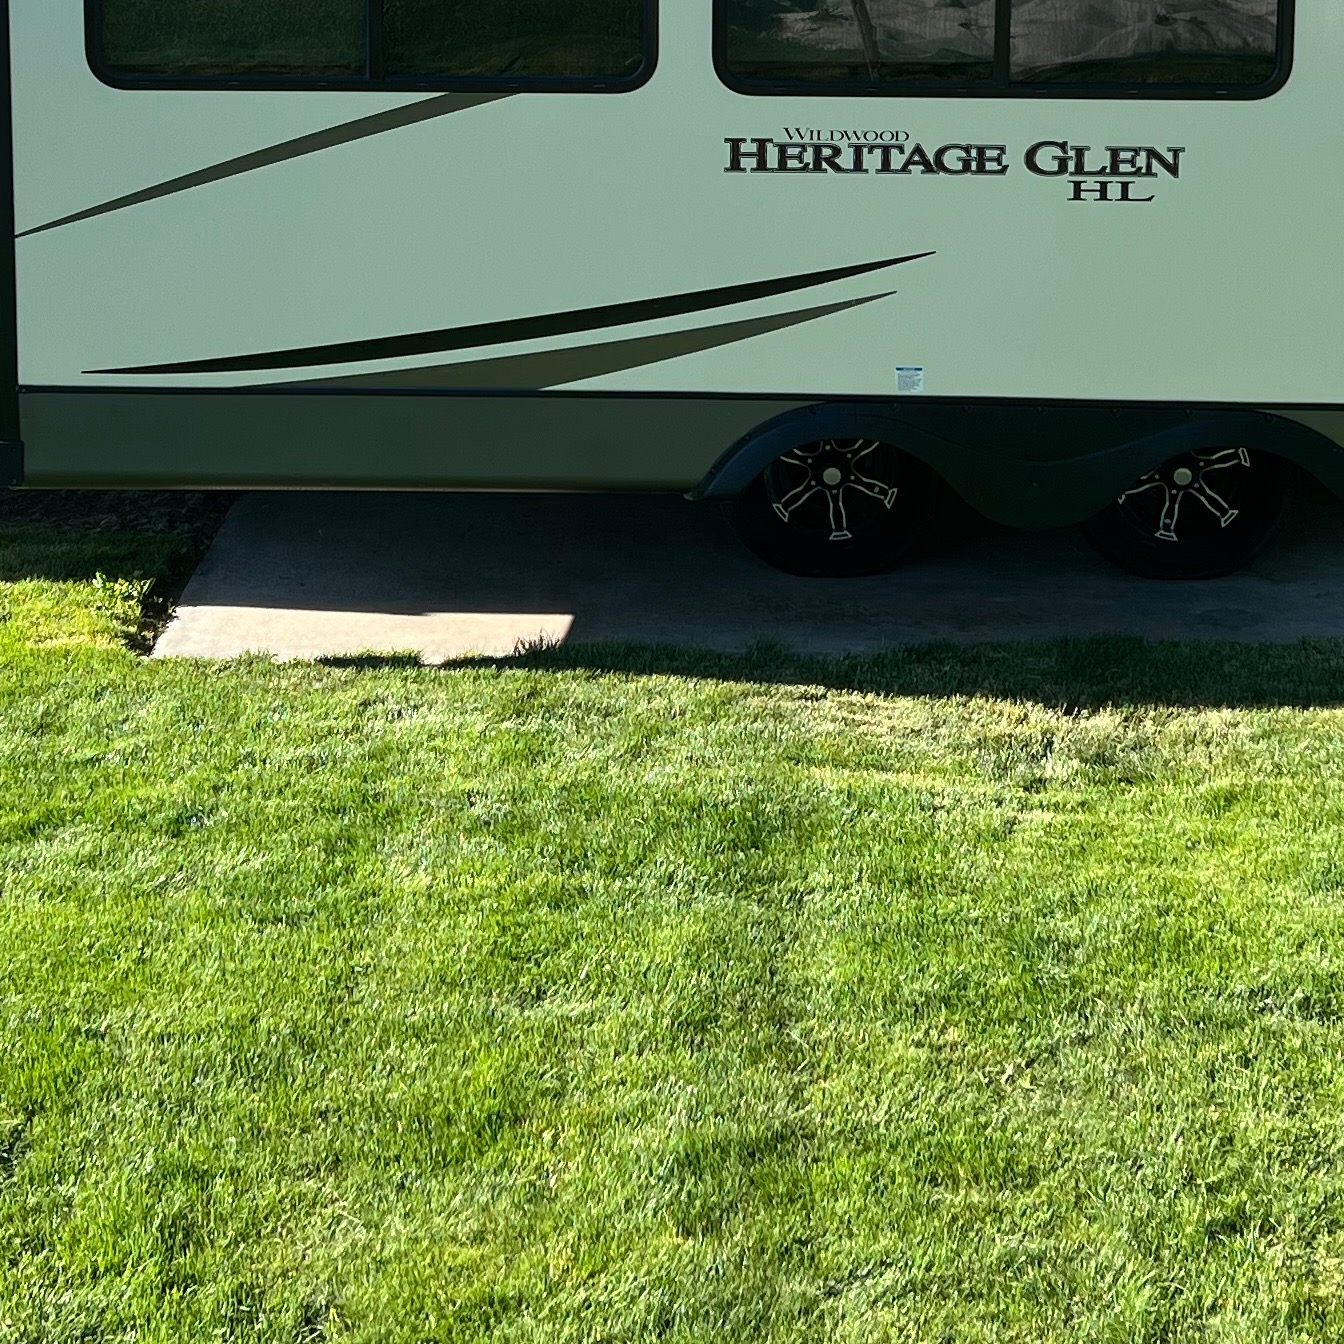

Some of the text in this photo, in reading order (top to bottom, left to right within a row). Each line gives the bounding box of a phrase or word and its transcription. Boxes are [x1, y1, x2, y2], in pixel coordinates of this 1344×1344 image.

[783, 127, 910, 142] WILDWOOD
[723, 137, 1185, 178] HERITAGE GLEN
[1067, 180, 1155, 202] HL
